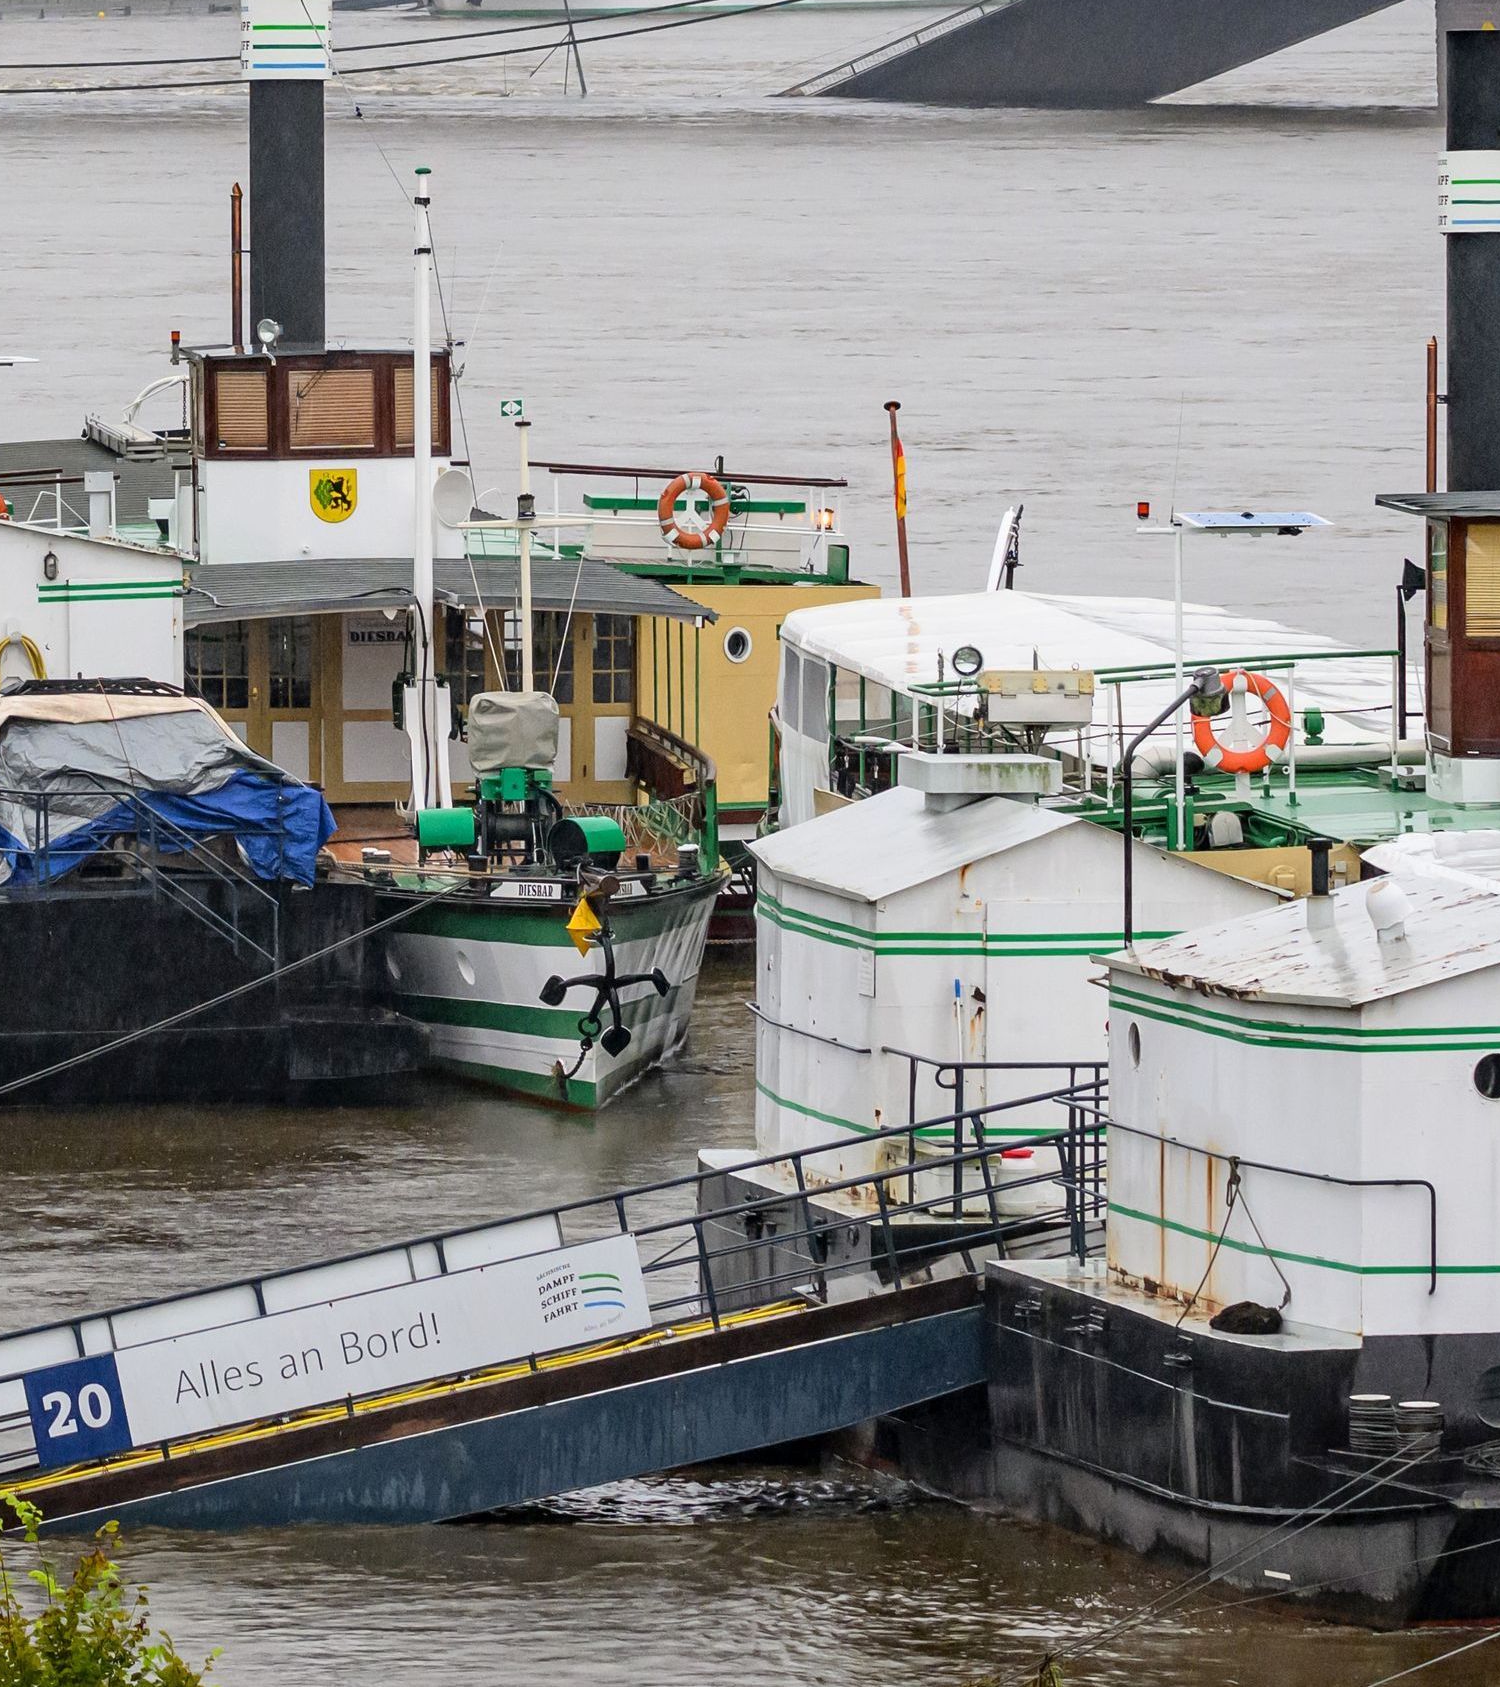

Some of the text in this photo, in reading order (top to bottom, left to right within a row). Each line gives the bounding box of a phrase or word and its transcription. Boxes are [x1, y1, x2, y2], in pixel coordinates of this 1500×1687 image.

[350, 631, 414, 642] DIESBA
[518, 883, 553, 897] DIESBAR
[538, 1273, 575, 1295] DAMPF
[541, 1287, 577, 1309] SCHIFF
[544, 1302, 578, 1323] FAHRT
[176, 1312, 442, 1404] Alles an Bord!
[42, 1382, 112, 1439] 20
